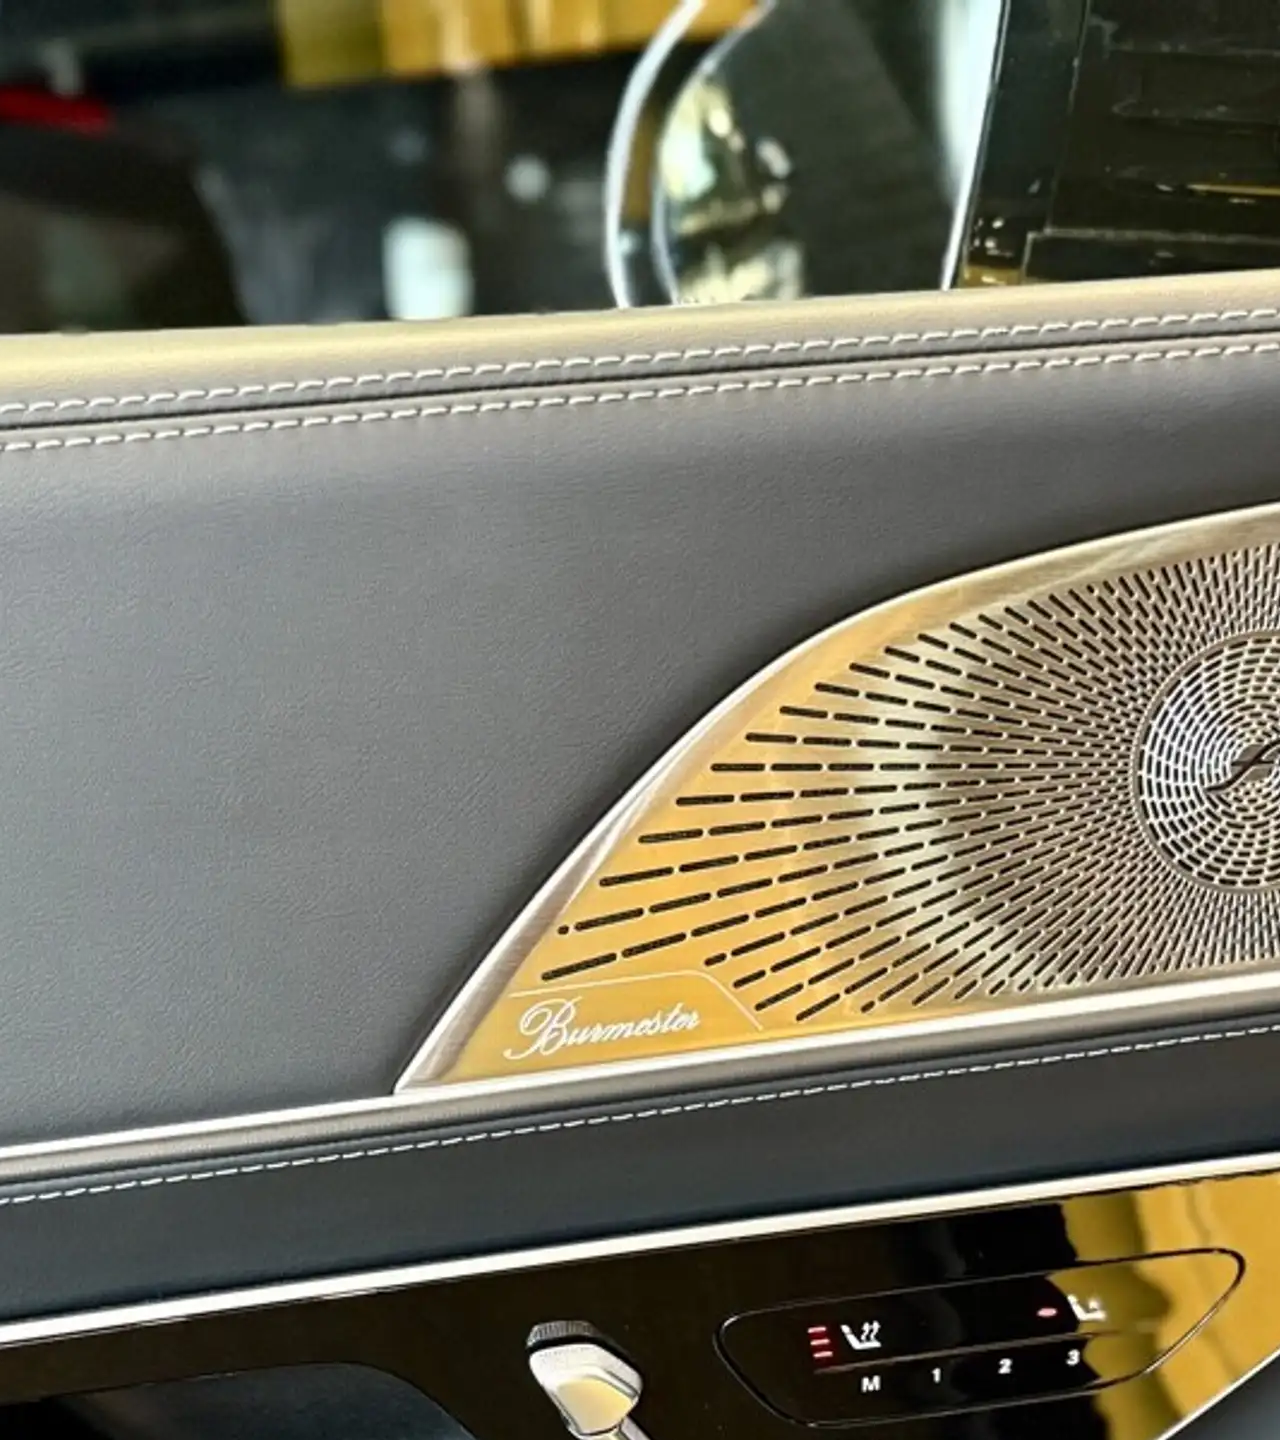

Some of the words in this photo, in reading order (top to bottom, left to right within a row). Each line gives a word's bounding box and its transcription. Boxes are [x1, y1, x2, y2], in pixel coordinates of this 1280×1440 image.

[503, 995, 701, 1060] Burmester
[861, 1375, 881, 1393] M
[931, 1367, 942, 1384] 1
[997, 1358, 1013, 1375] 2
[1065, 1349, 1081, 1366] 3
